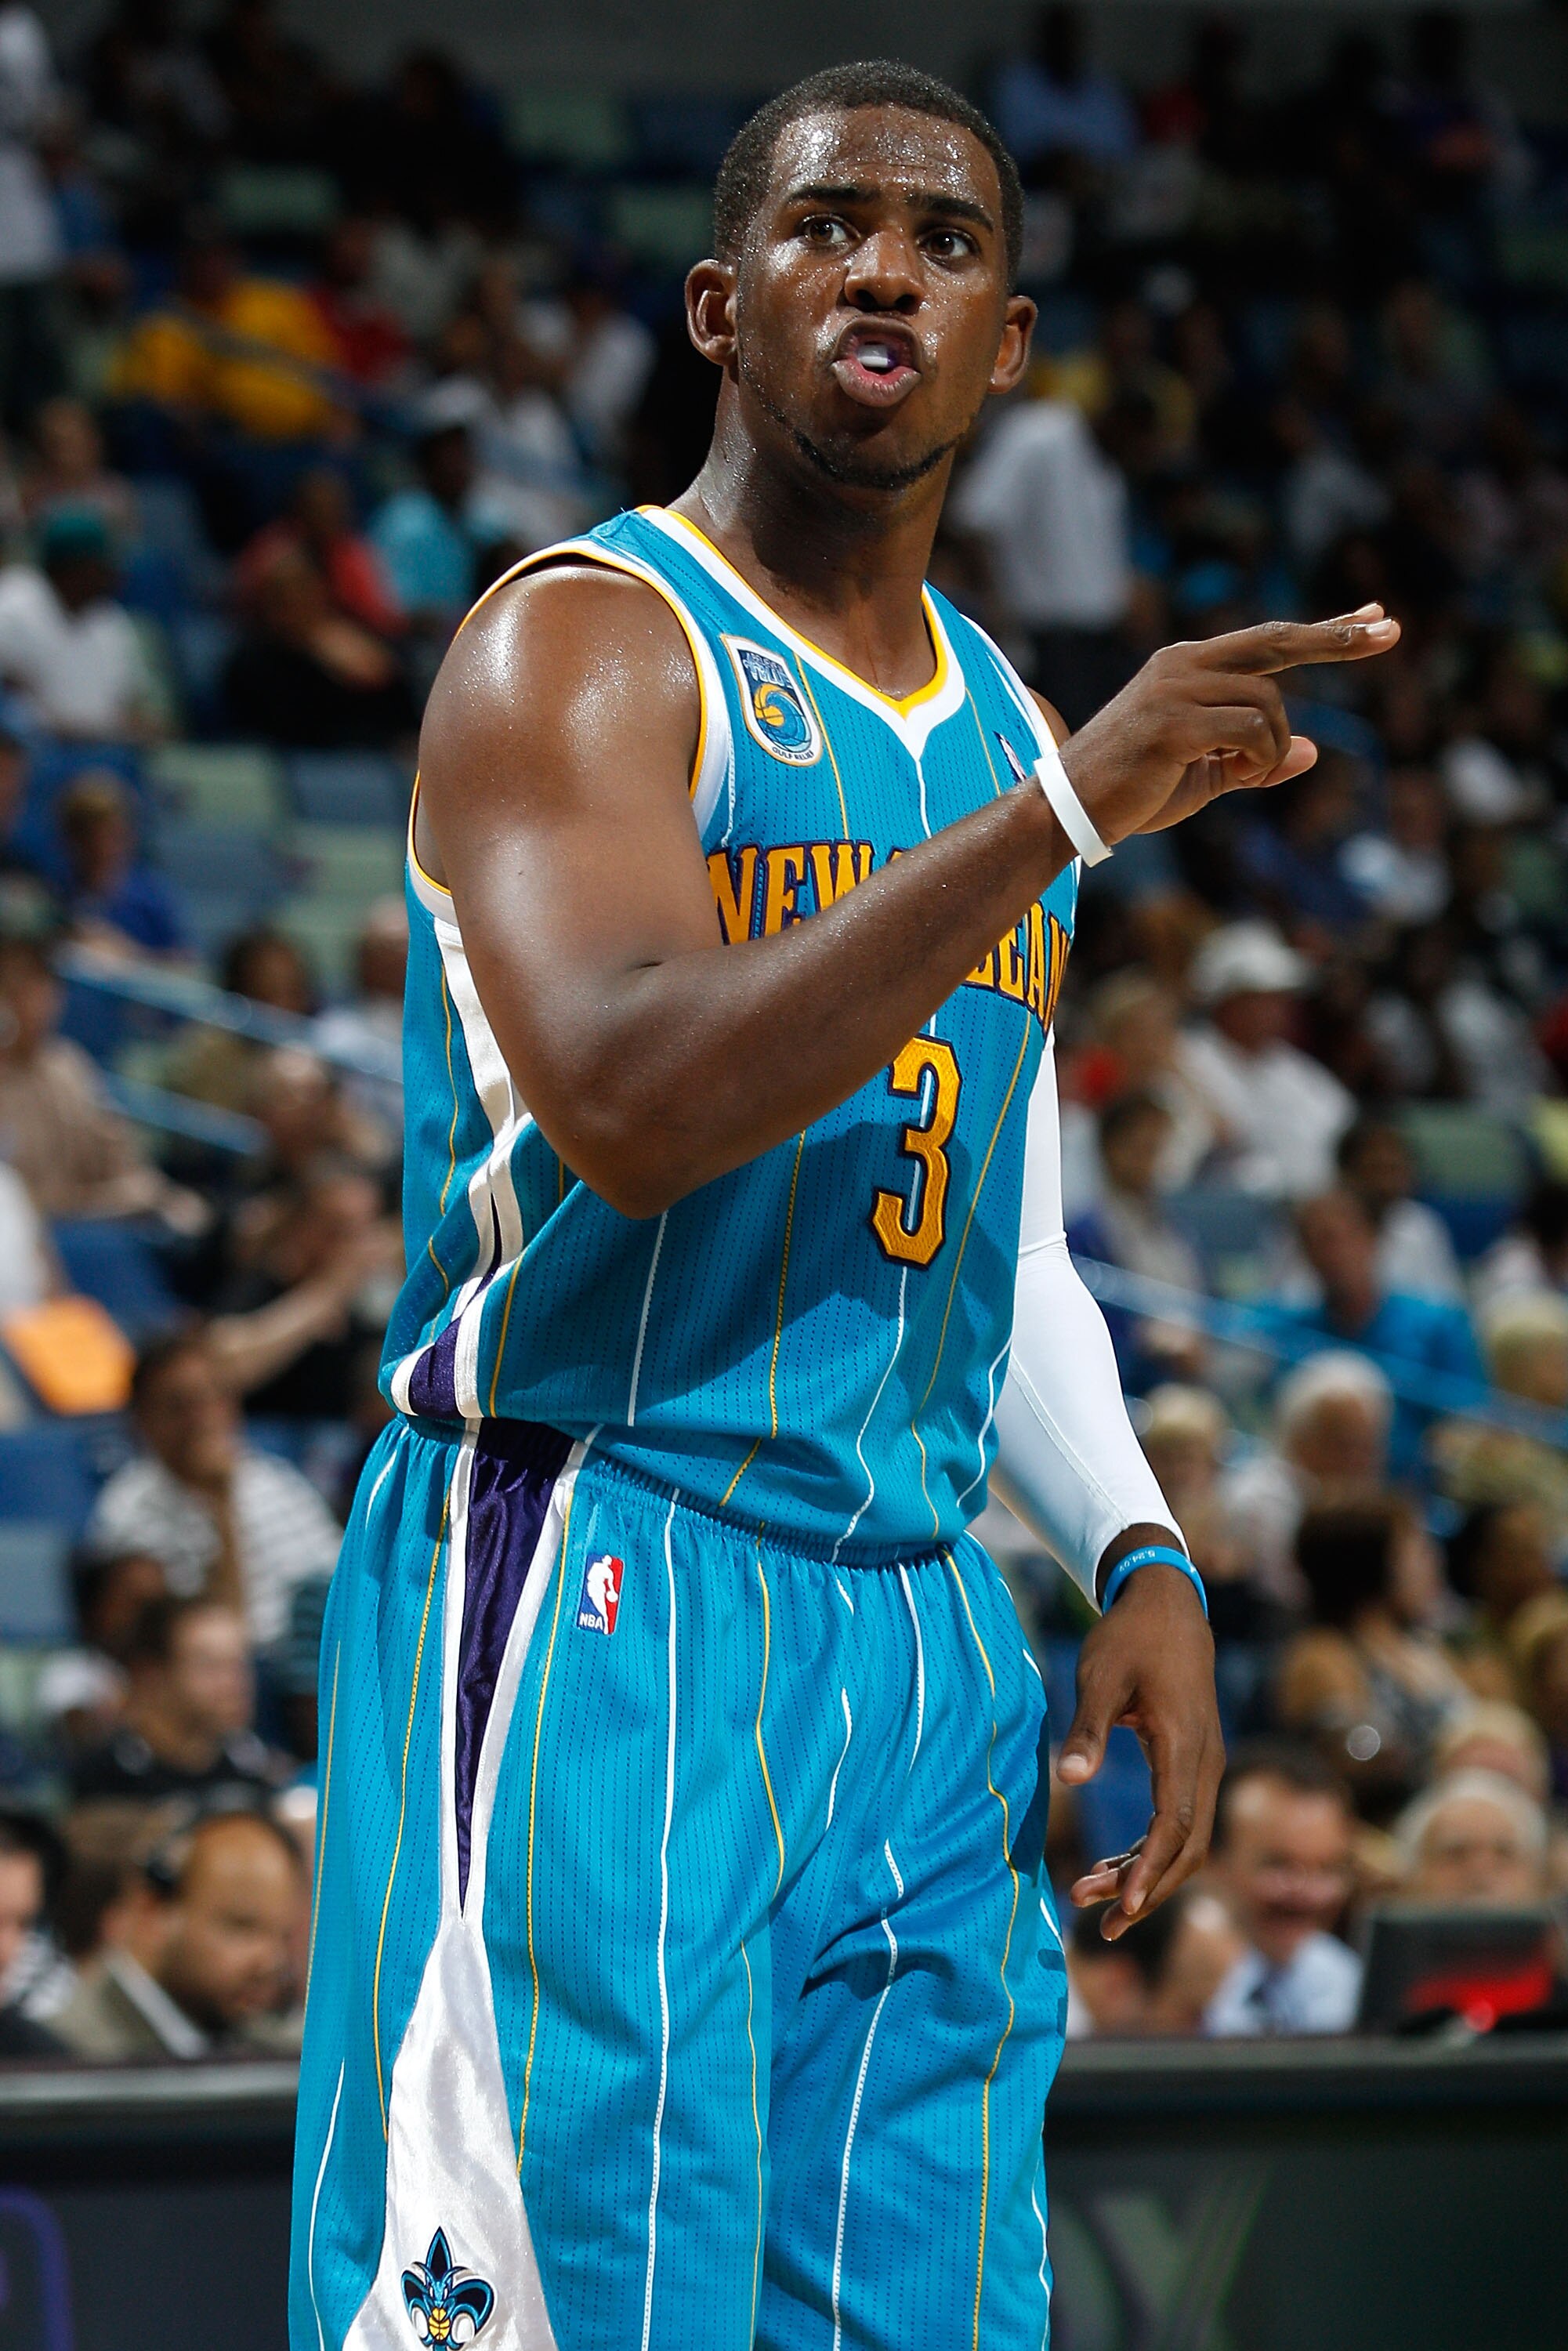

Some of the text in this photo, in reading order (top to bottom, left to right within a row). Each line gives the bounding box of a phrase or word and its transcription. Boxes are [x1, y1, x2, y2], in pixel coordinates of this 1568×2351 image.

[772, 746, 815, 760] GULF RELIEF
[705, 839, 875, 945] NEW
[866, 1034, 964, 1269] 3
[579, 1612, 603, 1630] NBA
